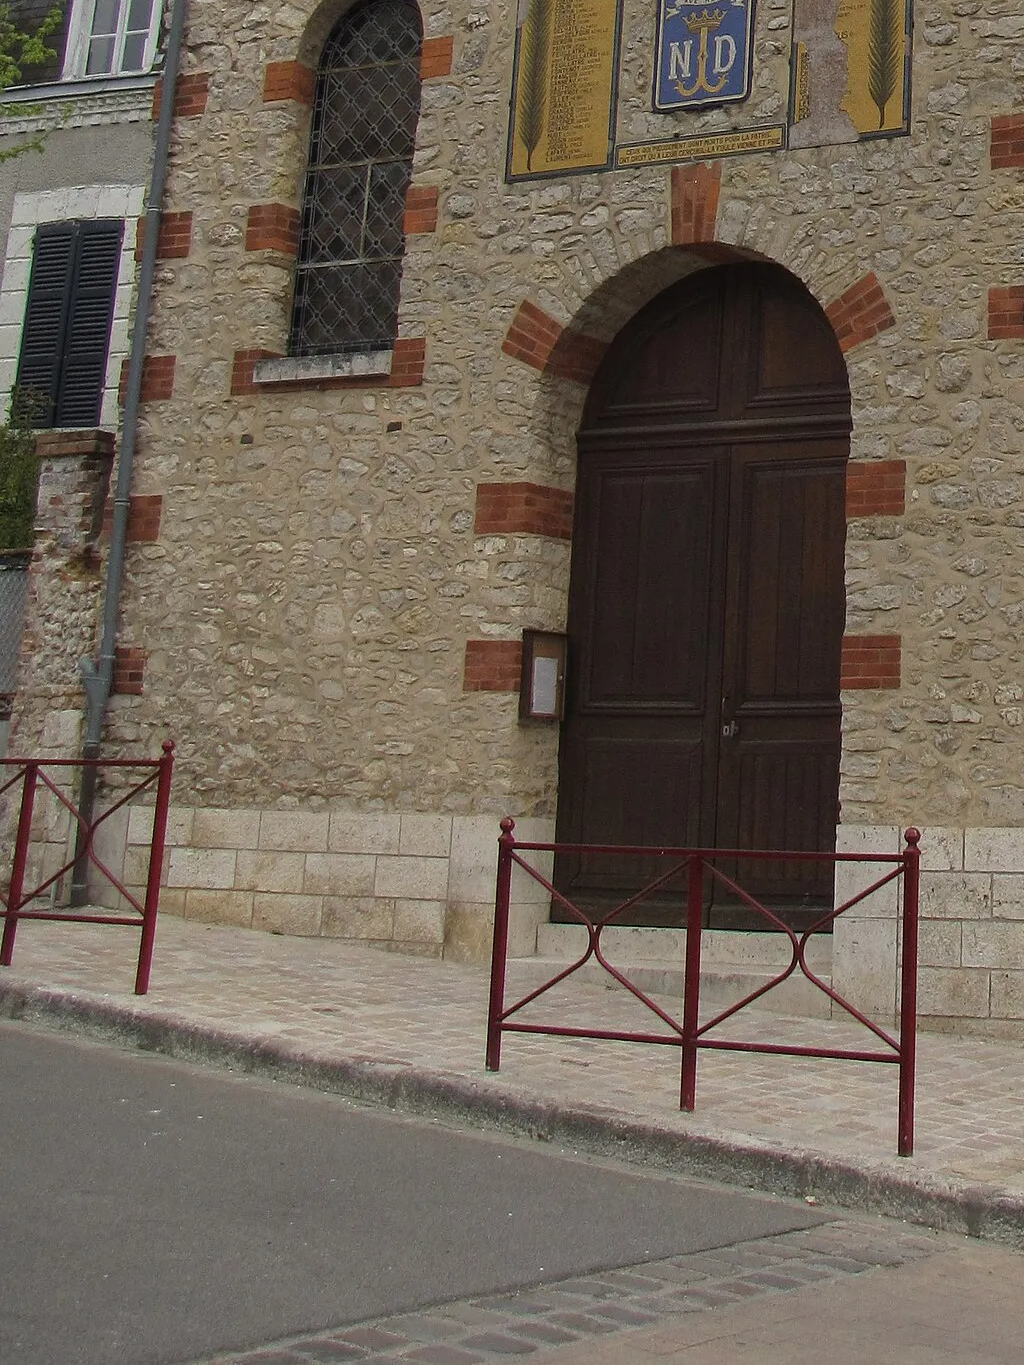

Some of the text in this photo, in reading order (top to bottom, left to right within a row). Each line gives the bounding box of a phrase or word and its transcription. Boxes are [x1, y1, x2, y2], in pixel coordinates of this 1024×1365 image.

[668, 35, 736, 79] N D
[725, 135, 740, 144] POUR
[741, 133, 750, 141] LA
[619, 155, 632, 164] ONT
